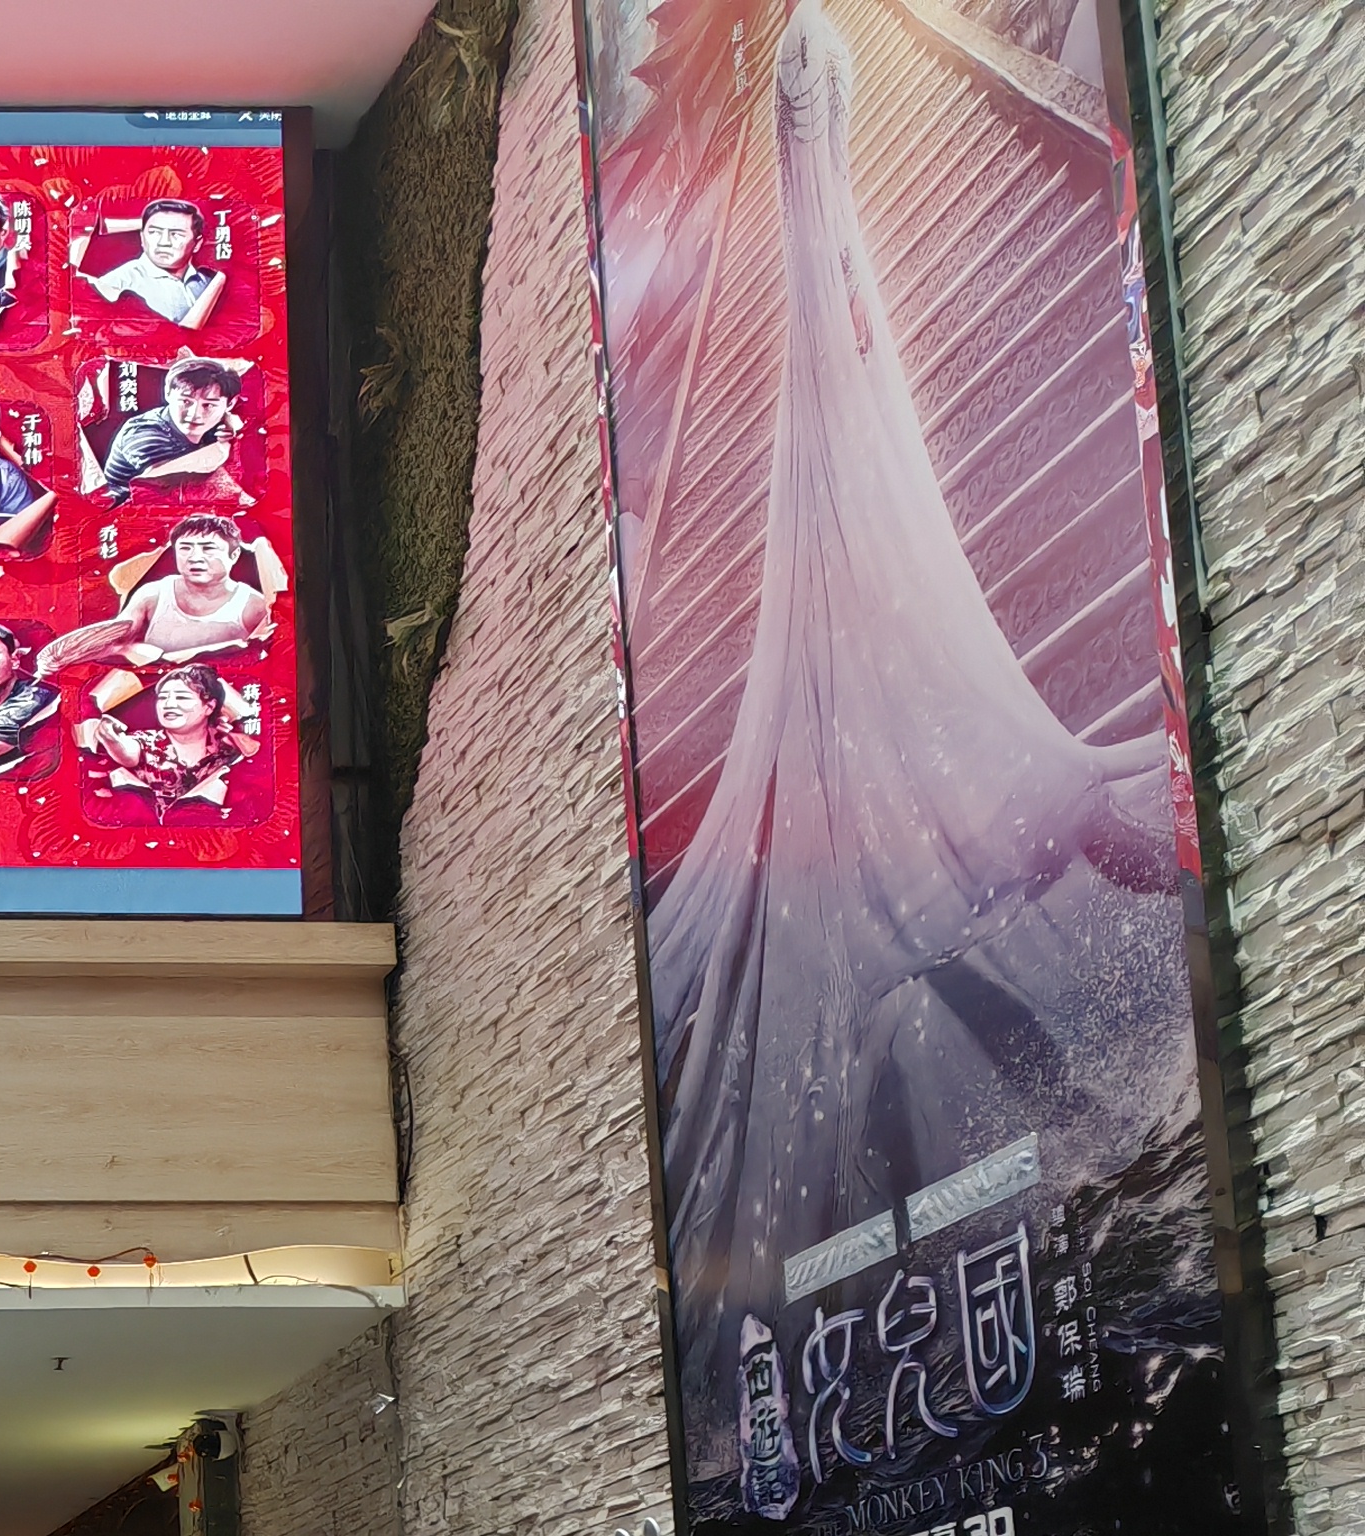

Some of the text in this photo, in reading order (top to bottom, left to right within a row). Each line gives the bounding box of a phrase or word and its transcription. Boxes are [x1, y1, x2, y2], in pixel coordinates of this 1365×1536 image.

[119, 361, 138, 411] 刘奕铁
[22, 413, 42, 465] 于和伟
[99, 525, 118, 559] 乔杉
[1086, 1306, 1101, 1392] CHEANG
[846, 1473, 949, 1532] MONKEY
[957, 1447, 1024, 1500] KING
[1028, 1432, 1048, 1479] 3
